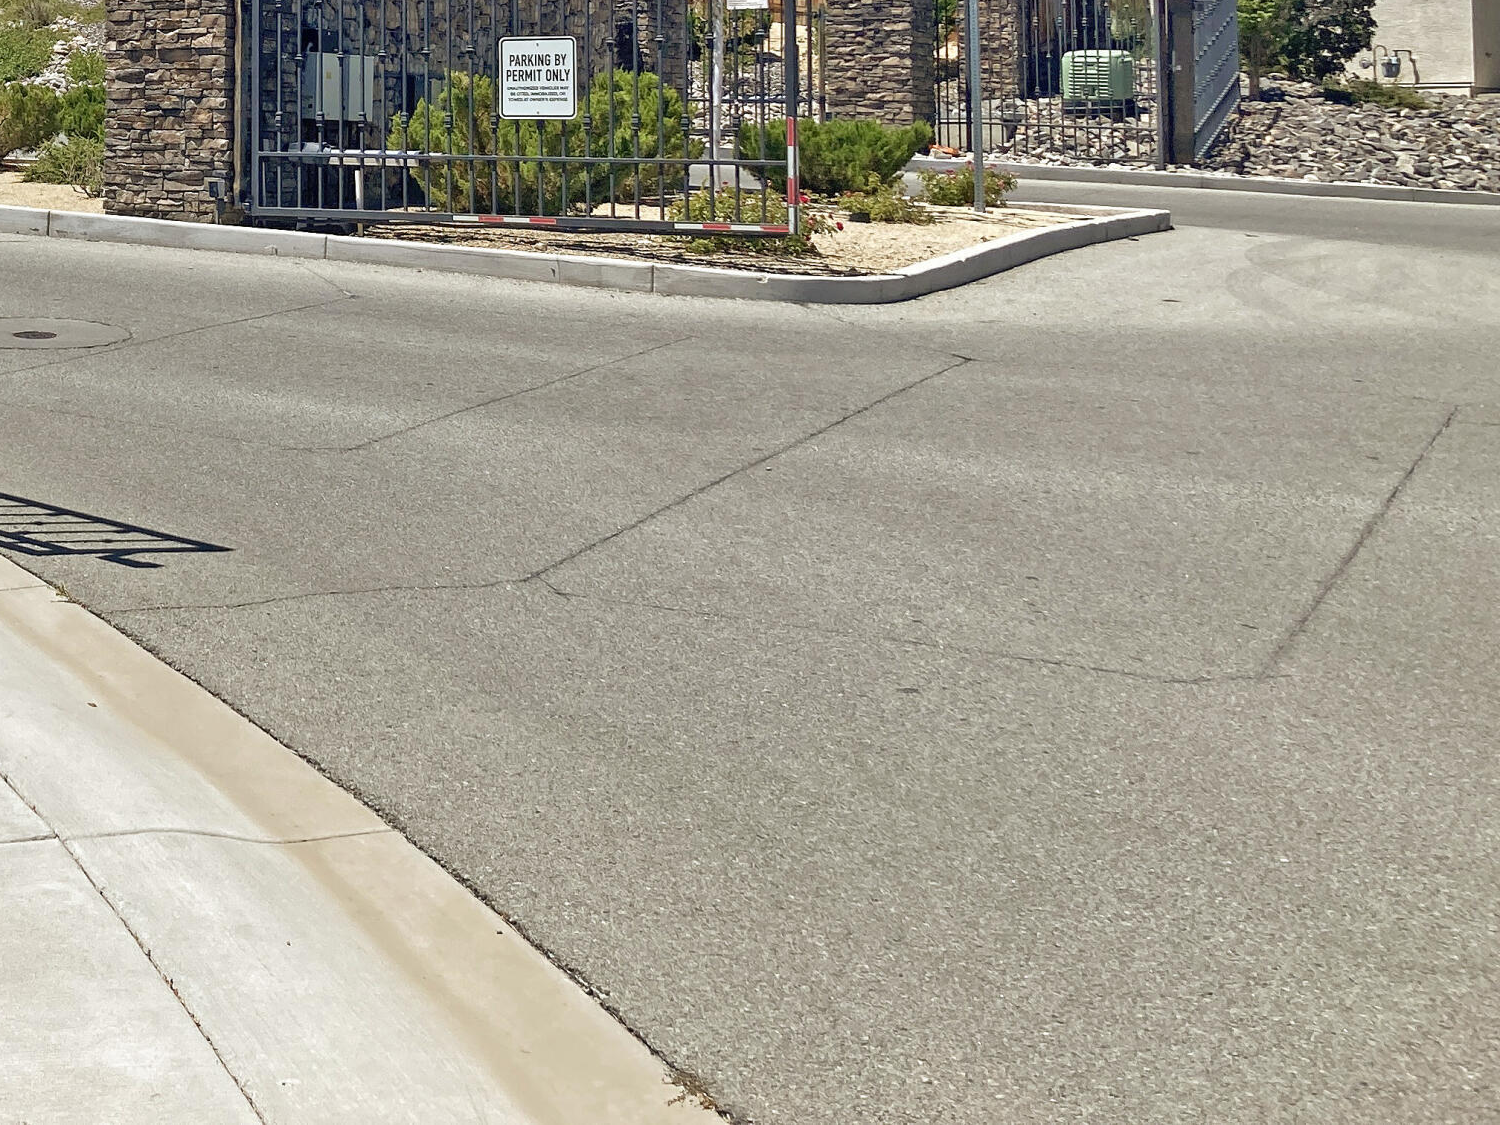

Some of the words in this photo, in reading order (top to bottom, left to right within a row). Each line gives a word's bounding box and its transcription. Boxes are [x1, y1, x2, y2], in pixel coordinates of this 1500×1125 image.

[509, 54, 551, 67] PARKING
[554, 53, 567, 66] BY
[506, 69, 543, 82] PERMIT
[545, 68, 571, 82] ONLY
